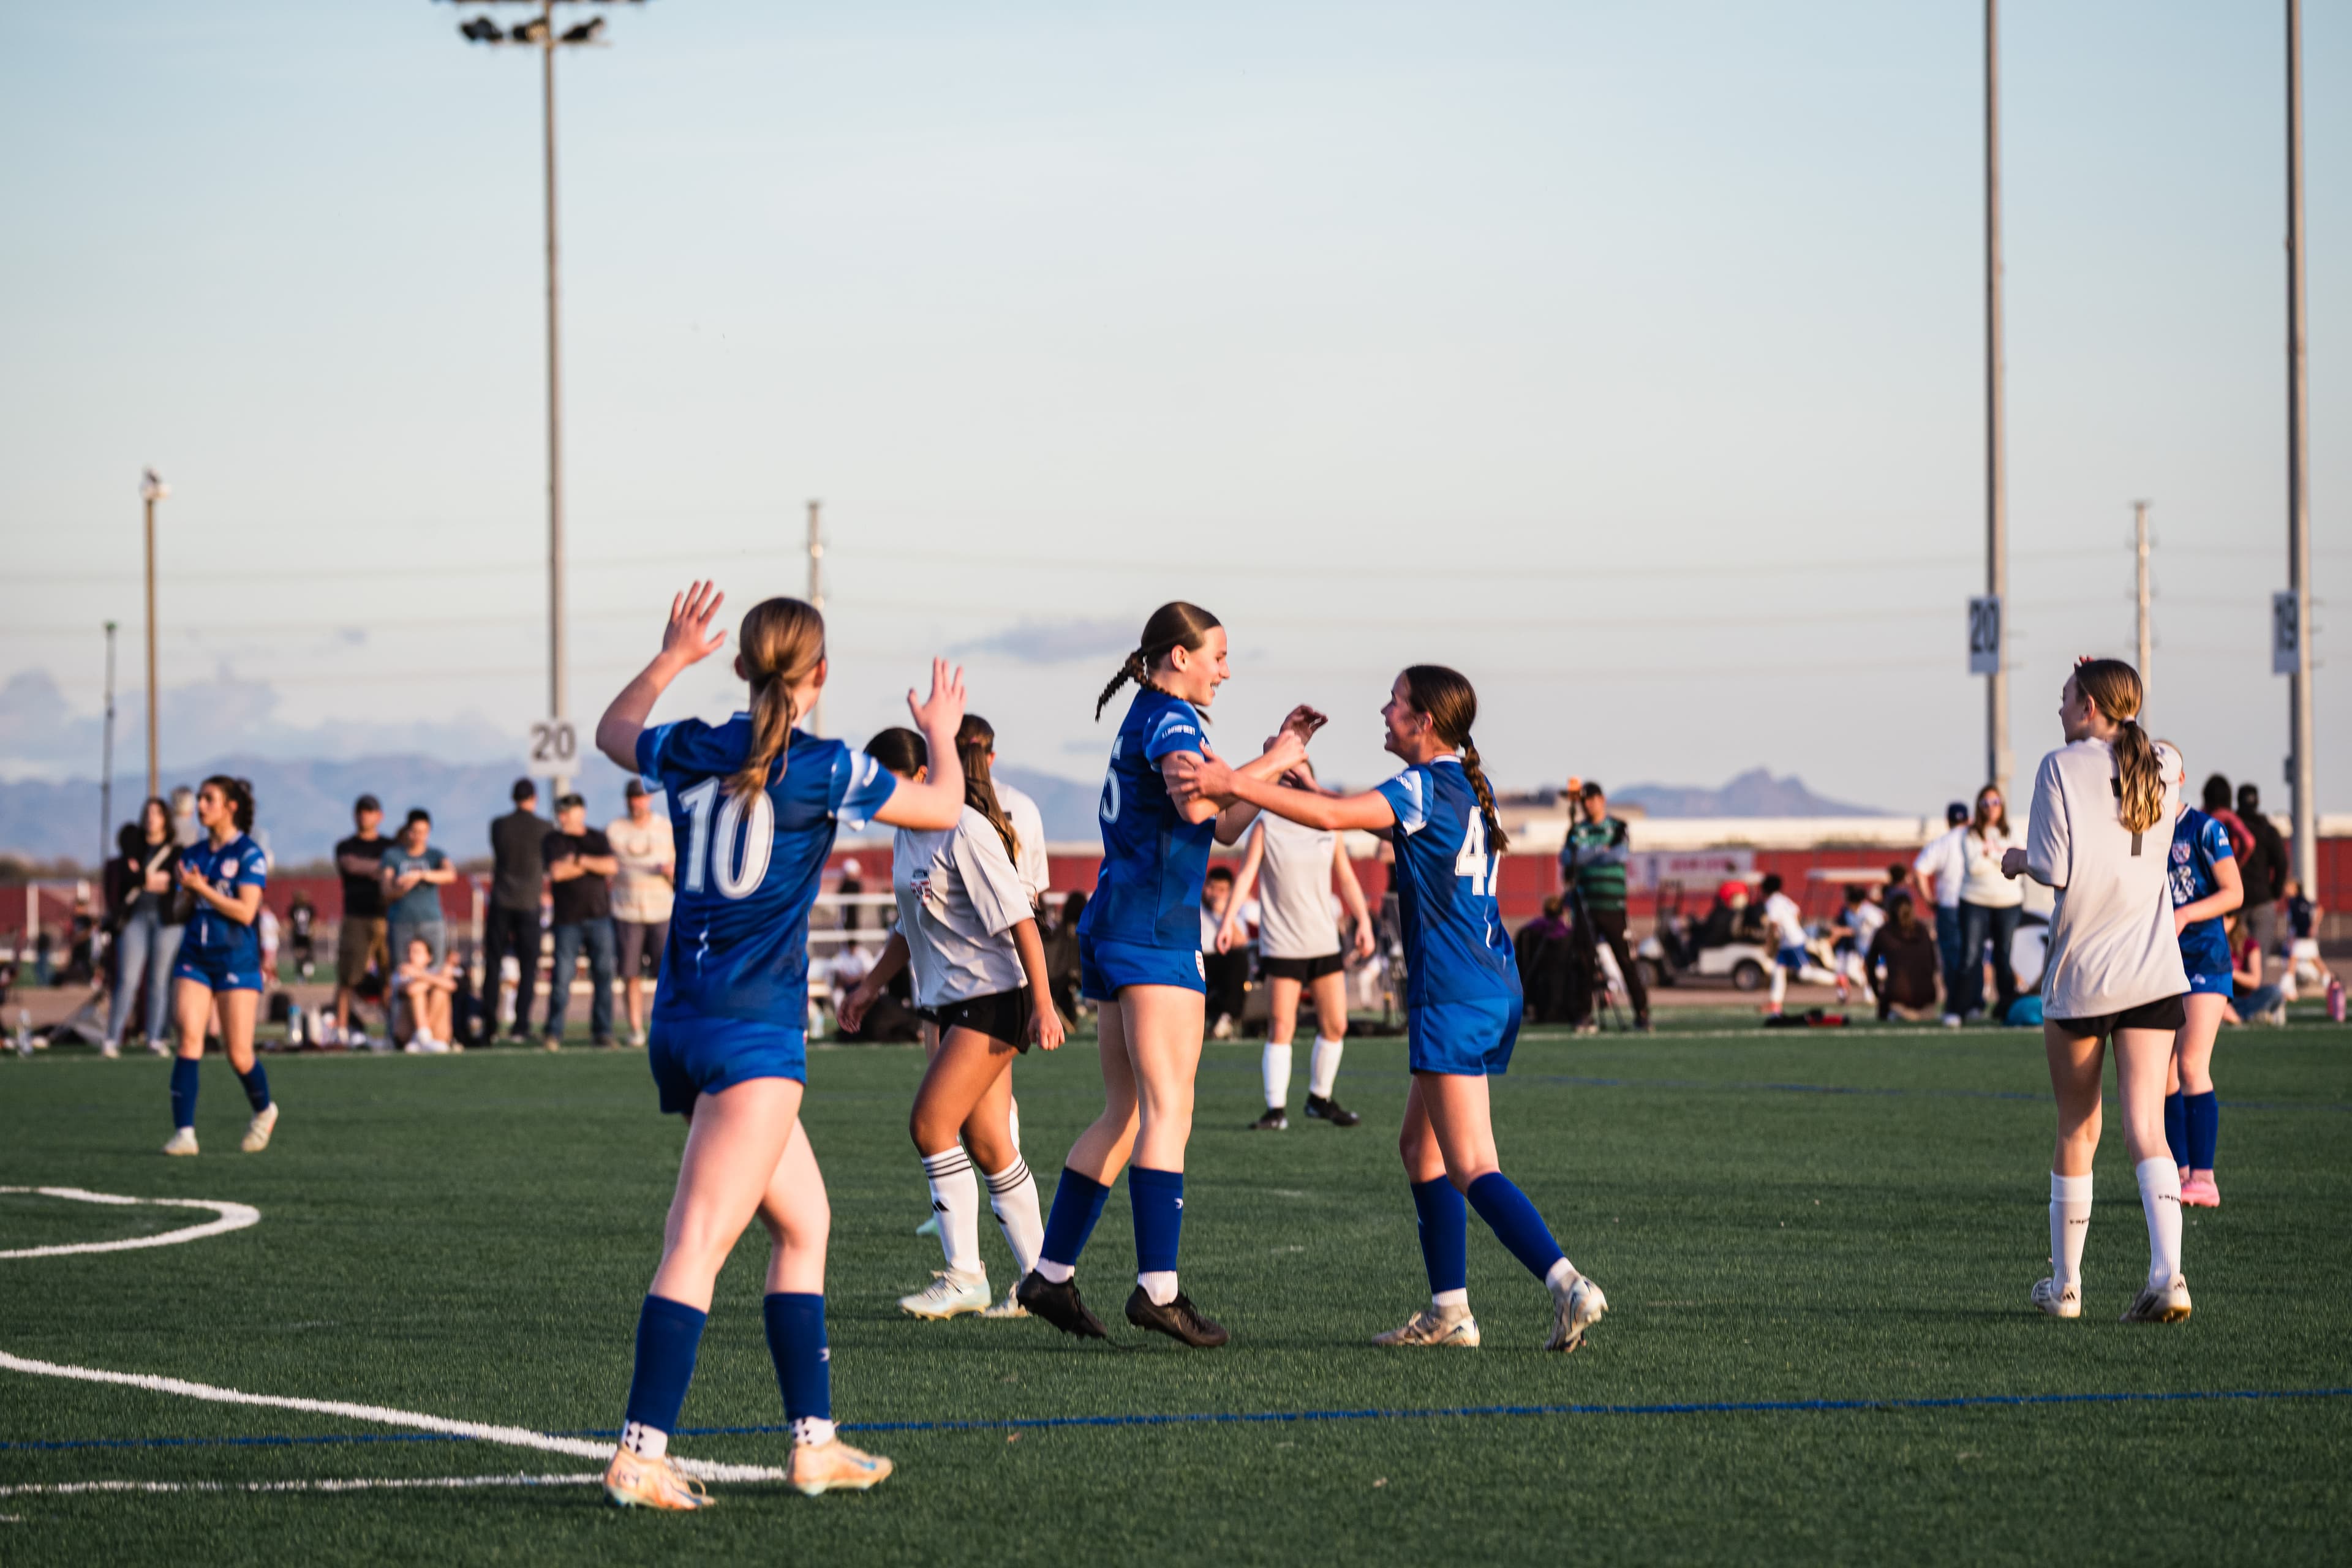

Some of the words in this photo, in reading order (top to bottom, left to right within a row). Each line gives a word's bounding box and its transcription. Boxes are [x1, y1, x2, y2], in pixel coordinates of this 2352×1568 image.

[1970, 600, 1999, 654] 20
[532, 724, 576, 761] 20
[677, 775, 775, 900] 10
